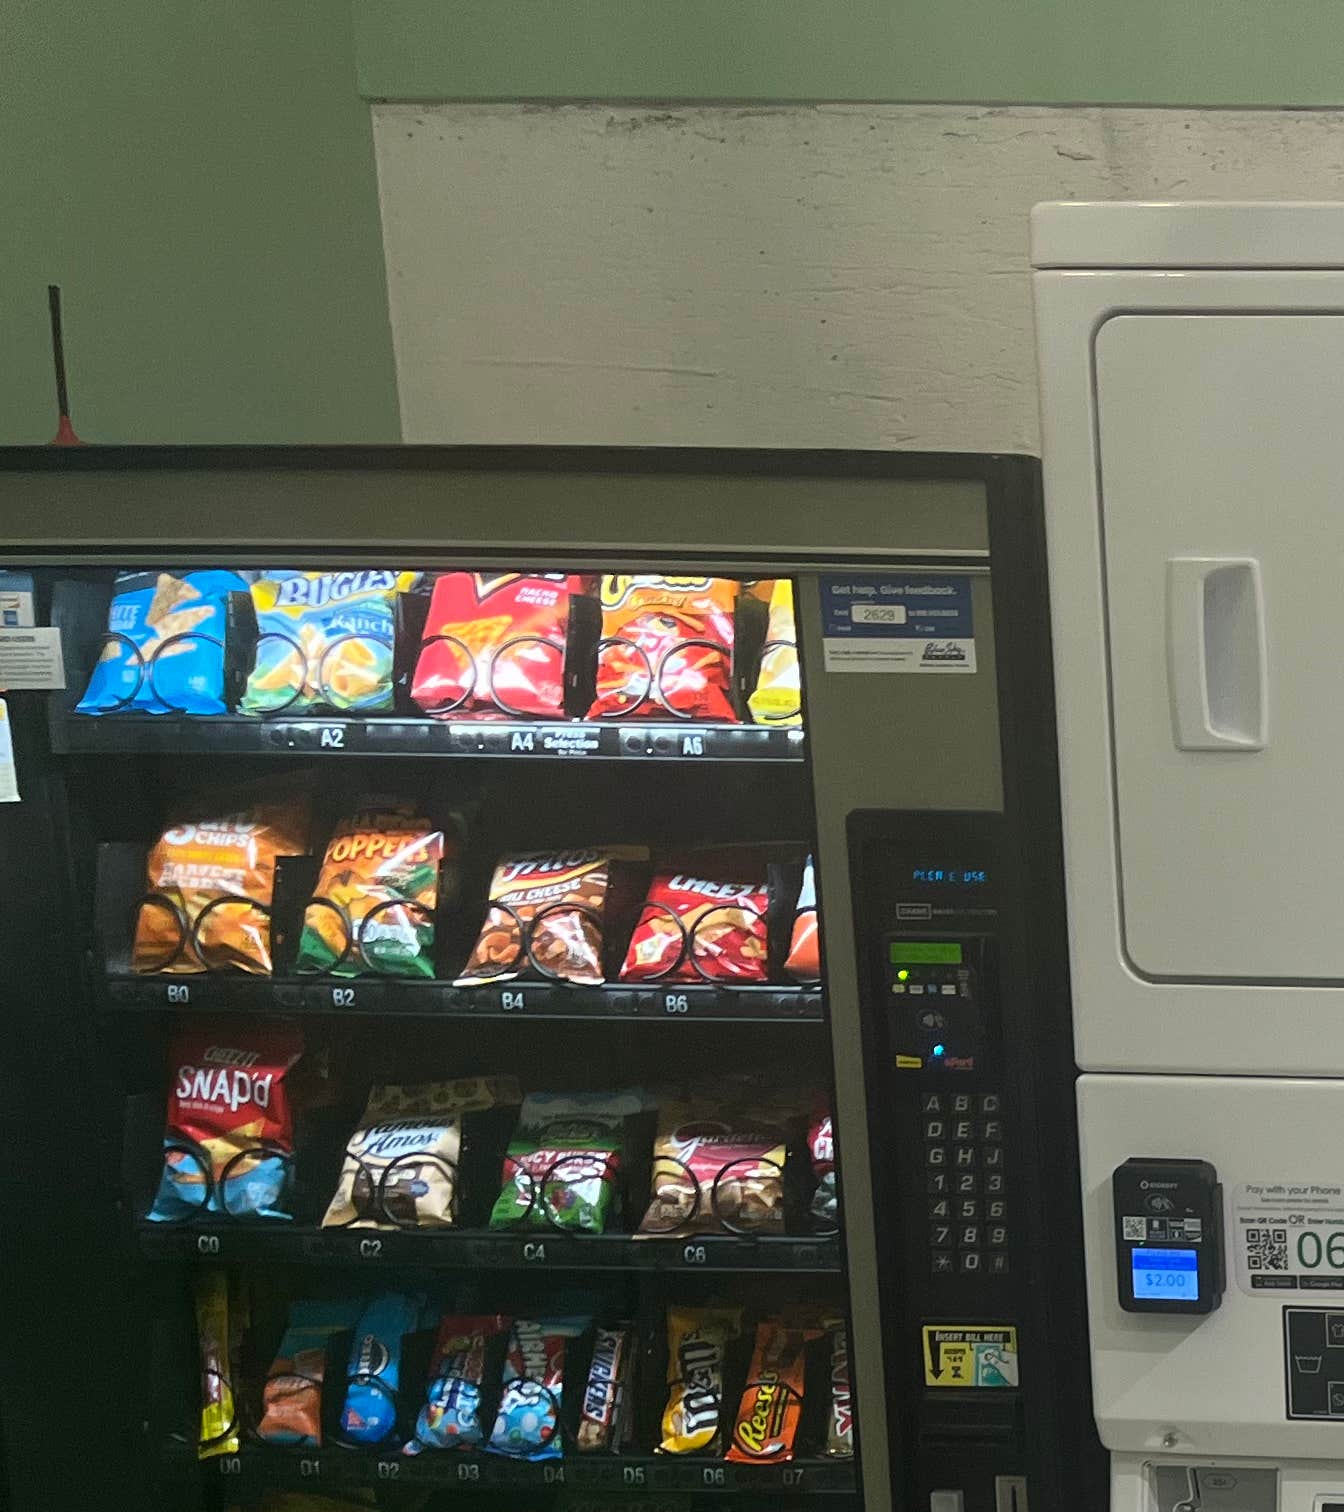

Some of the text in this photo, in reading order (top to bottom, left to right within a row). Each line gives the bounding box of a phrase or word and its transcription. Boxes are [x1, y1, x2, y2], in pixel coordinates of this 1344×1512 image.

[275, 570, 396, 606] BUGLES
[327, 613, 393, 635] Ranch
[320, 728, 345, 748] A2
[511, 732, 534, 751] A4
[195, 832, 248, 847] CHIPS
[332, 988, 355, 1006] B2
[502, 993, 523, 1010] B4
[665, 995, 688, 1013] B6
[176, 1065, 273, 1112] SNAP'd
[926, 1096, 997, 1111] A B C
[927, 1123, 999, 1138] D E F
[360, 1132, 435, 1155] Amos
[929, 1149, 999, 1164] G H J
[934, 1175, 1001, 1191] 1 2 3
[1246, 1185, 1341, 1197] Pay with your Phone
[933, 1202, 1003, 1217] 4 5 6
[1289, 1215, 1304, 1225] OR
[936, 1228, 1005, 1243] 7 8 9
[360, 1240, 382, 1257] C2
[523, 1244, 545, 1261] C4
[965, 1254, 978, 1269] 0
[1145, 1274, 1185, 1287] $2.00
[457, 1465, 479, 1480] D3
[623, 1468, 645, 1484] D5
[703, 1469, 725, 1485] D6
